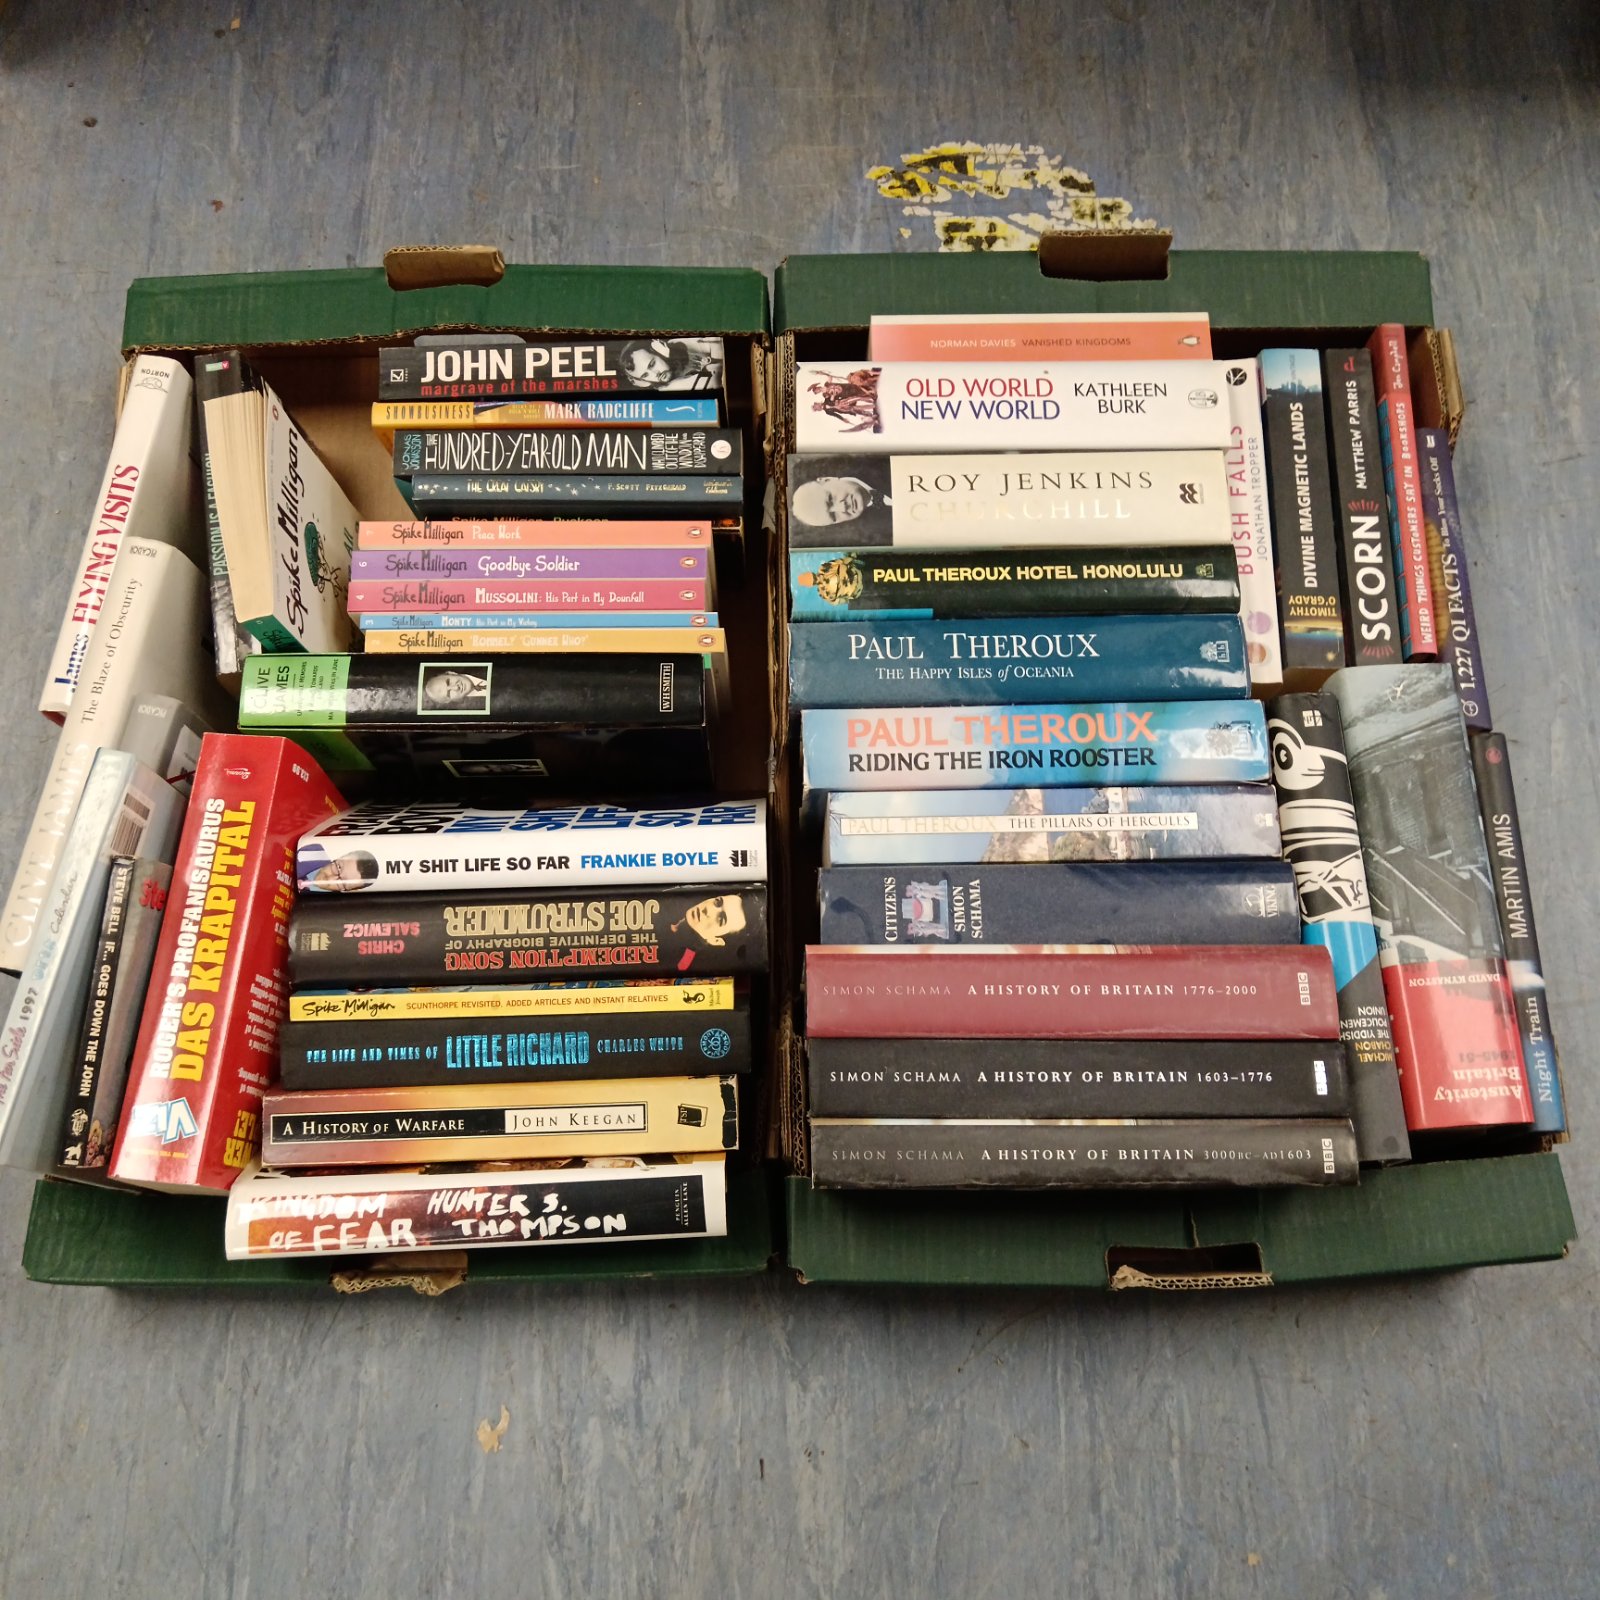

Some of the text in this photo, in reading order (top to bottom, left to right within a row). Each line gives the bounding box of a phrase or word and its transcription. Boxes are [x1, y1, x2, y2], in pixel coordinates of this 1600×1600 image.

[931, 338, 1131, 348] NORMAN DAVIES VANISHED KINGDOMS
[421, 349, 512, 382] JOHN
[526, 346, 616, 379] PEEL
[421, 376, 618, 398] margrave of the marshes
[906, 378, 1054, 398] OLD WORLD
[1074, 382, 1167, 396] KATHLEEN
[386, 405, 470, 420] SHOWBUSINESS
[544, 404, 582, 418] MARK
[588, 402, 654, 418] RADCLIFFE
[902, 400, 1060, 420] NEW WORLD
[1098, 400, 1146, 414] BURK
[1348, 380, 1368, 490] MATTHEW PARRIS
[586, 433, 646, 470] MAN
[276, 427, 306, 547] Milligan
[908, 471, 1152, 496] ROY JENKINS
[1289, 402, 1318, 588] DIVINE MAGNETIC LANDS
[1228, 425, 1254, 575] BUSH FALLS
[1248, 436, 1268, 561] JONATHAN TROPPER
[1396, 402, 1433, 644] WEIRD THINGS CUSTOMERS SAY IN BOOKSHOPS
[72, 464, 140, 625] FLYING VISITS
[478, 555, 580, 578] Goodbye Soldier
[873, 564, 1184, 582] PAUL THEROUX HOTEL HONOLULU
[1350, 514, 1392, 641] SCORN
[280, 544, 309, 638] Spike
[475, 588, 542, 604] MUSSOLINI:
[545, 591, 559, 603] His
[582, 592, 590, 603] in
[593, 591, 606, 606] My
[609, 591, 644, 604] Downfall
[1288, 594, 1336, 606] O'GRADY
[1290, 606, 1337, 617] TIMOTHY
[1442, 554, 1476, 689] 1,227 QI FACTS
[80, 577, 142, 724] The Blaze of Obscurity
[848, 632, 1100, 660] PAUL THEROUX
[876, 664, 1074, 682] THE HAPPY ISLES of OCEANIA
[662, 664, 672, 710] WHSMITH
[848, 712, 1158, 748] PAUL THEROUX
[849, 748, 1157, 772] RIDING THE IRON ROOSTER
[1009, 814, 1190, 829] THE PILLARS OF HERCULES
[386, 852, 718, 874] MY SHIT LIFE SO FAR FRANKIE BOYLE
[1492, 814, 1528, 938] MARTIN AMIS
[444, 899, 660, 936] JOE STRUMMER
[884, 876, 897, 942] CITIZENS
[952, 886, 966, 932] SIMON
[969, 879, 983, 939] SCHAMA
[150, 798, 225, 1079] ROGER'S PROFANISAURUS
[170, 800, 256, 1082] DAS KRAPITAL
[344, 922, 420, 938] SALEWICZ
[444, 933, 658, 950] THE DEFINITIVE BIOGRAPHY OF
[358, 940, 404, 954] CHRIS
[444, 945, 659, 971] REDEMPTION SONG
[79, 868, 128, 1097] STEVE BELL IF... GOES DOWN THE JOHN
[1408, 973, 1501, 987] DAVID KYNASTON
[302, 998, 396, 1017] Spike Milligan
[406, 1001, 458, 1010] SCUNTHORPE
[461, 1000, 503, 1009] REVISITED,
[506, 999, 532, 1007] ADDED
[534, 998, 572, 1006] ARTICLES
[592, 996, 625, 1004] INSTANT
[628, 994, 668, 1002] RELATIVES
[446, 1031, 590, 1068] LITTLE RICHARD
[1355, 1041, 1392, 1051] CHABON
[1358, 1052, 1393, 1063] MICHAEL
[1526, 996, 1552, 1102] Night Train
[830, 1072, 1188, 1082] SIMON SCHAMA A HISTORY OF BRITAIN
[1453, 1066, 1521, 1082] Britain
[1434, 1086, 1524, 1103] Austerity
[282, 1118, 465, 1136] A HISTORY OF WARFARE
[514, 1112, 636, 1131] JOHN KEEGAN
[427, 1190, 568, 1216] HUNTER S.
[313, 1219, 417, 1252] FEAR
[451, 1213, 628, 1241] THOMPSON
